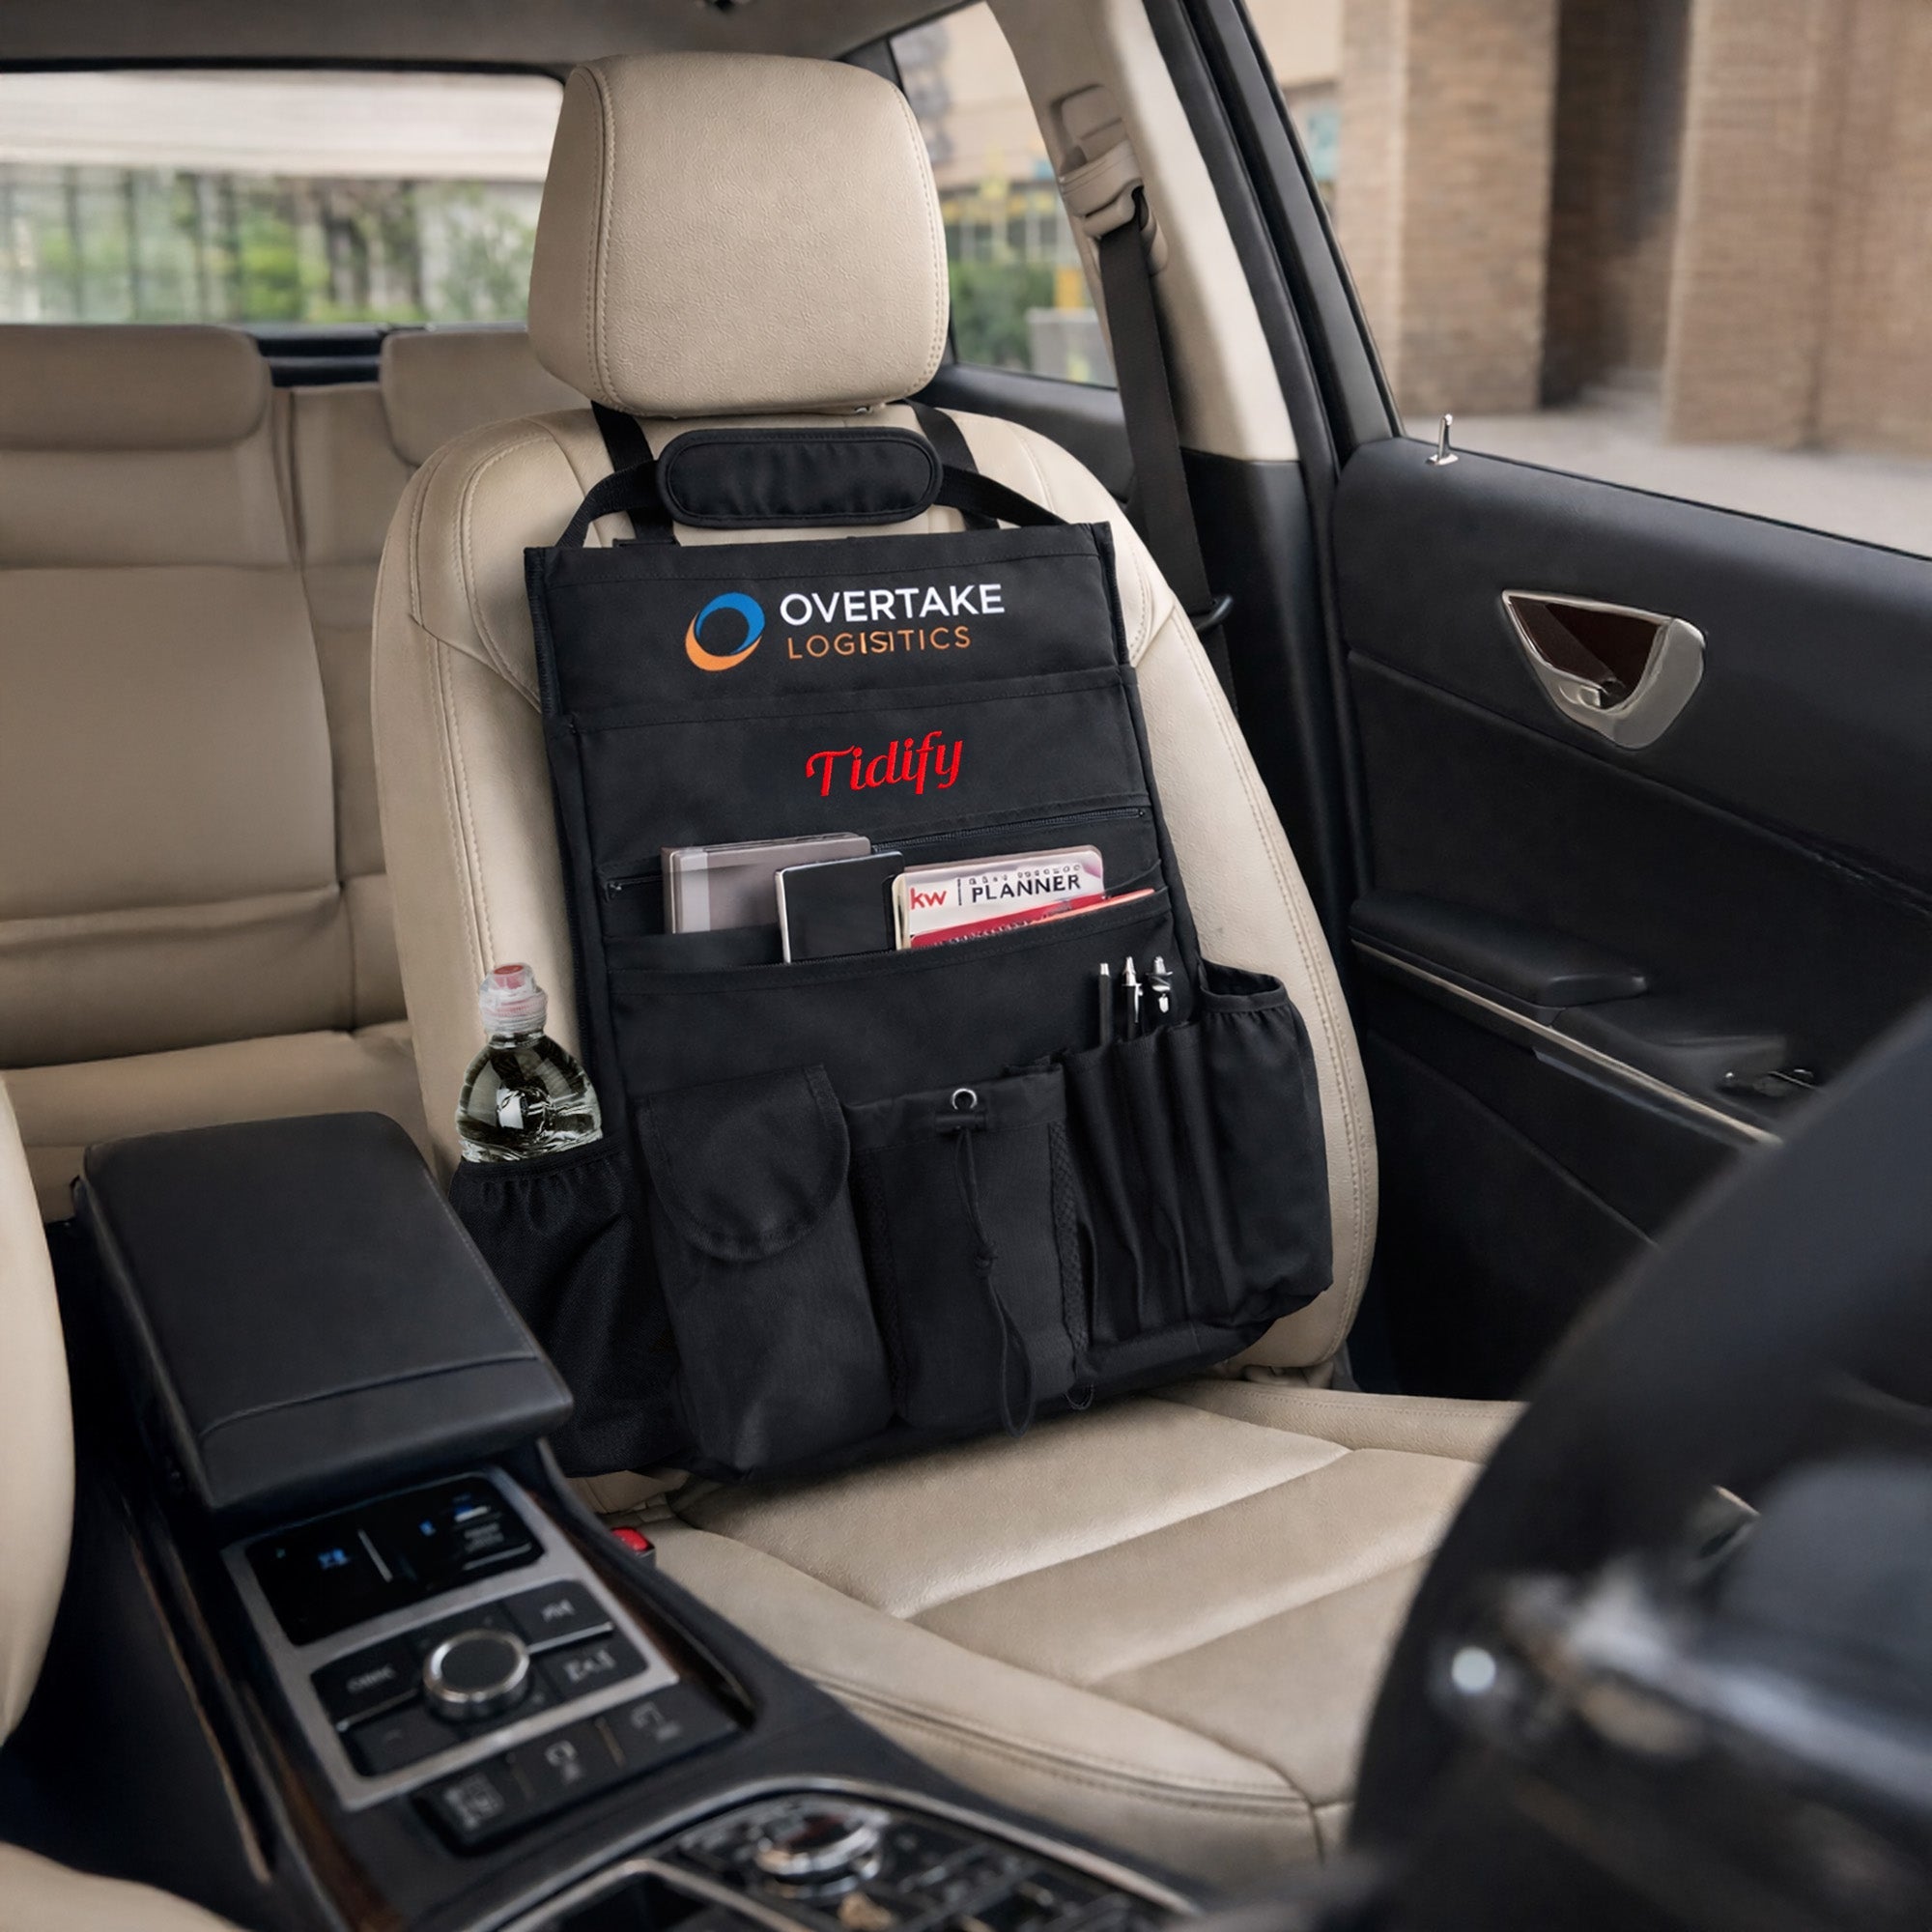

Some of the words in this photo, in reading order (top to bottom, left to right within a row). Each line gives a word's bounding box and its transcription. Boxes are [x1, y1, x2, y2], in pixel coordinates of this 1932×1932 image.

[780, 583, 1006, 626] OVERTAKE
[787, 626, 971, 660] LOGISITICS
[805, 730, 964, 797] Tidify
[910, 888, 947, 910] kw
[972, 874, 1081, 903] PLANNER
